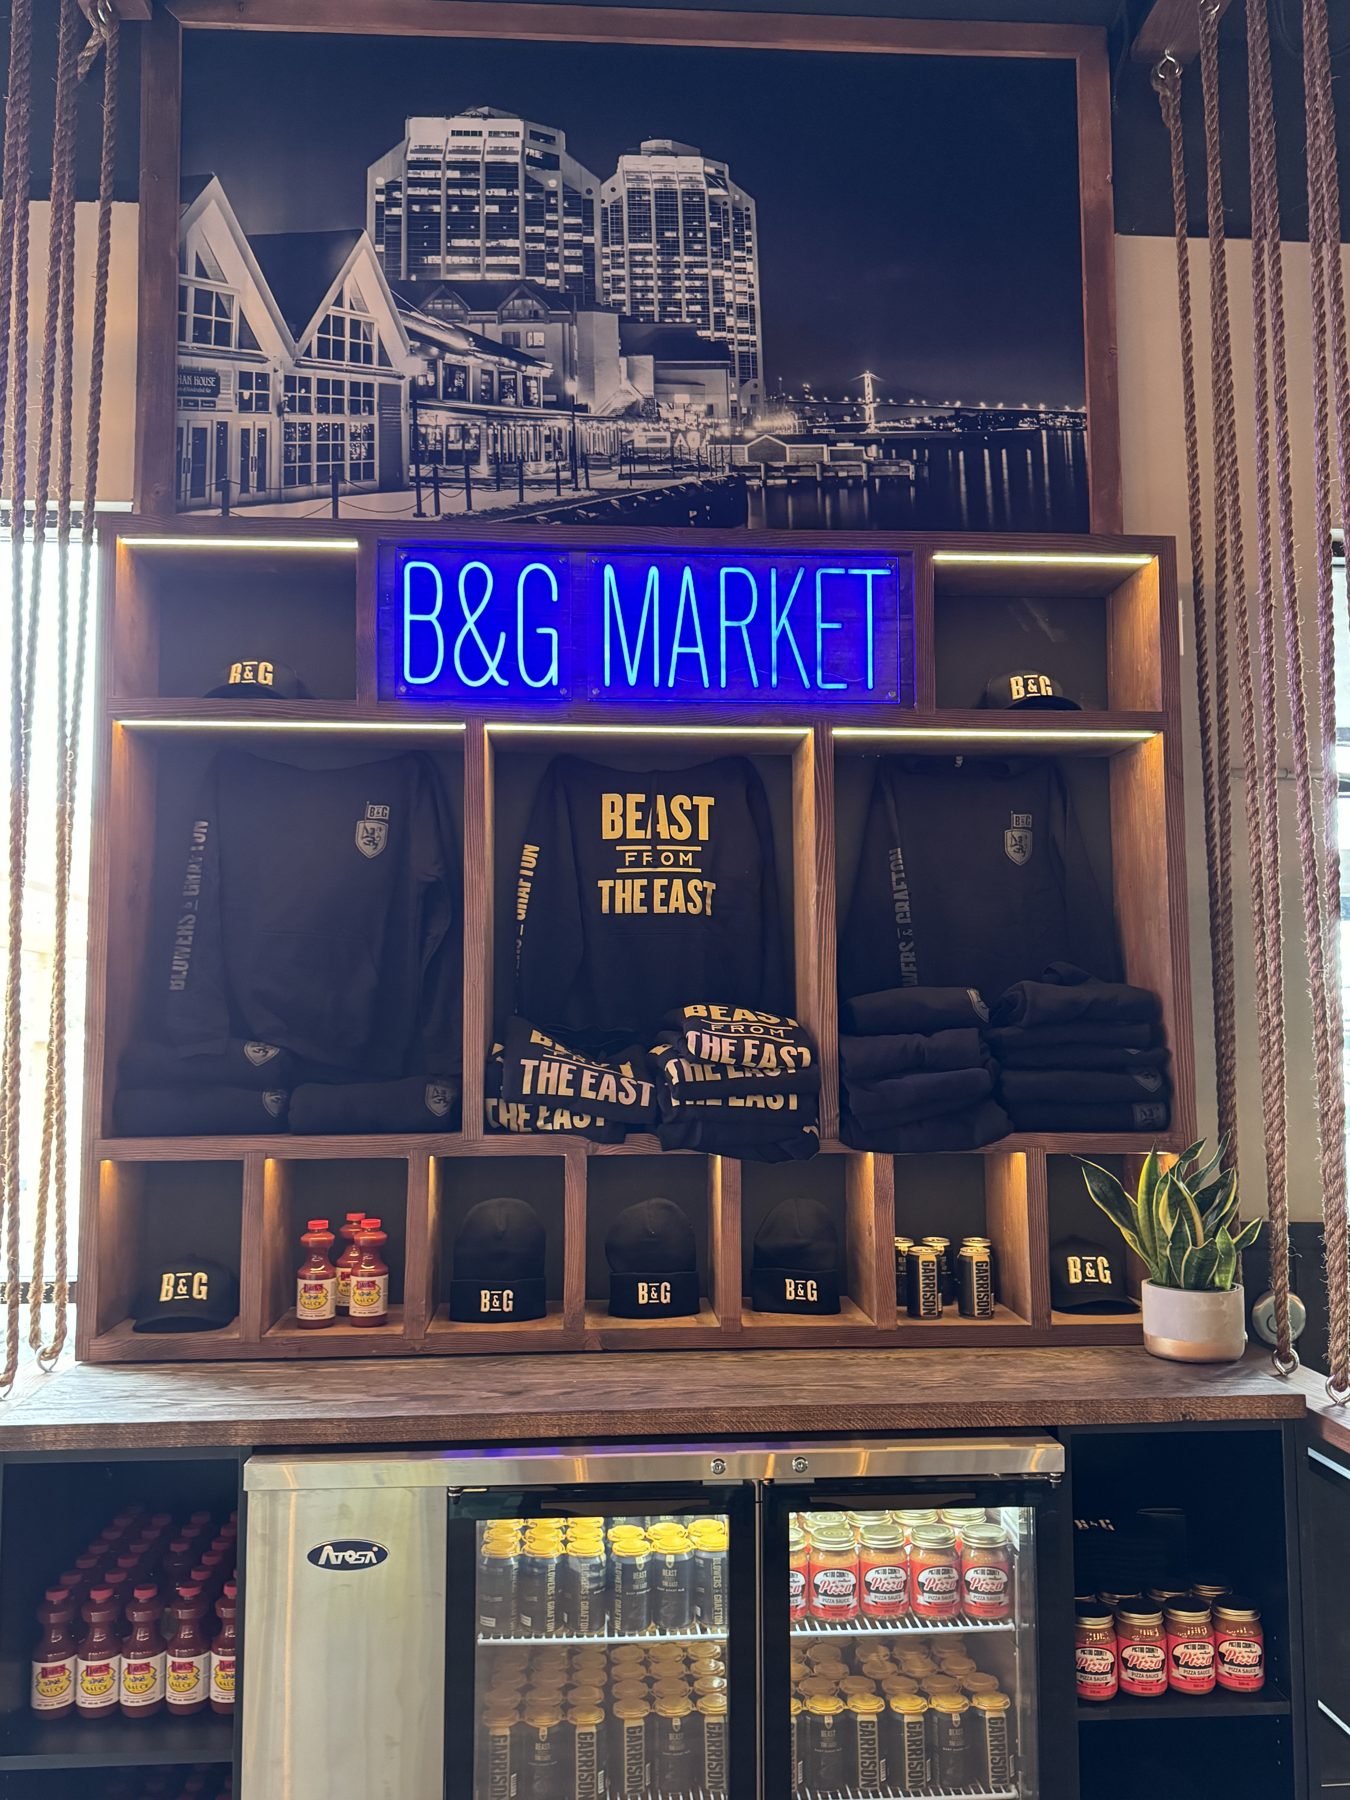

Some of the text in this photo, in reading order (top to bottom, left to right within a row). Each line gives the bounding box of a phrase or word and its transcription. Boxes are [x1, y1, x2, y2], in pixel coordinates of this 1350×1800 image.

[403, 561, 894, 690] B&G MARKET
[228, 661, 273, 685] B&G
[1010, 675, 1053, 700] B&G
[601, 793, 715, 841] BEAST
[624, 851, 693, 867] FROM
[597, 878, 716, 917] THE EAST
[684, 1005, 799, 1027] BEAS
[711, 1024, 785, 1038] FROM
[686, 1030, 811, 1069] THE EAST
[520, 1058, 577, 1097] THE
[580, 1069, 655, 1107] EAST
[1067, 1255, 1112, 1284] B&G
[159, 1271, 209, 1302] B&G
[637, 1281, 671, 1304] B&G
[784, 1278, 818, 1302] B&G
[921, 1260, 937, 1316] GARRISON
[974, 1260, 991, 1316] GARRISON
[480, 1290, 514, 1312] B&G
[819, 1580, 852, 1594] Pizza
[870, 1577, 904, 1591] Pizza
[924, 1577, 956, 1591] Pizza
[969, 1577, 1004, 1592] Pizza
[1076, 1657, 1110, 1672] Pizza
[1128, 1654, 1161, 1669] Pizza
[1179, 1651, 1212, 1666] Pizza
[1224, 1648, 1259, 1664] Pizza
[626, 1725, 644, 1794] GARRISON
[706, 1722, 724, 1790] GARRISON
[859, 1720, 878, 1789] GARRISON
[906, 1721, 924, 1790] GARRISON
[989, 1717, 1008, 1785] GARRISON
[577, 1732, 595, 1800] GARRISON
